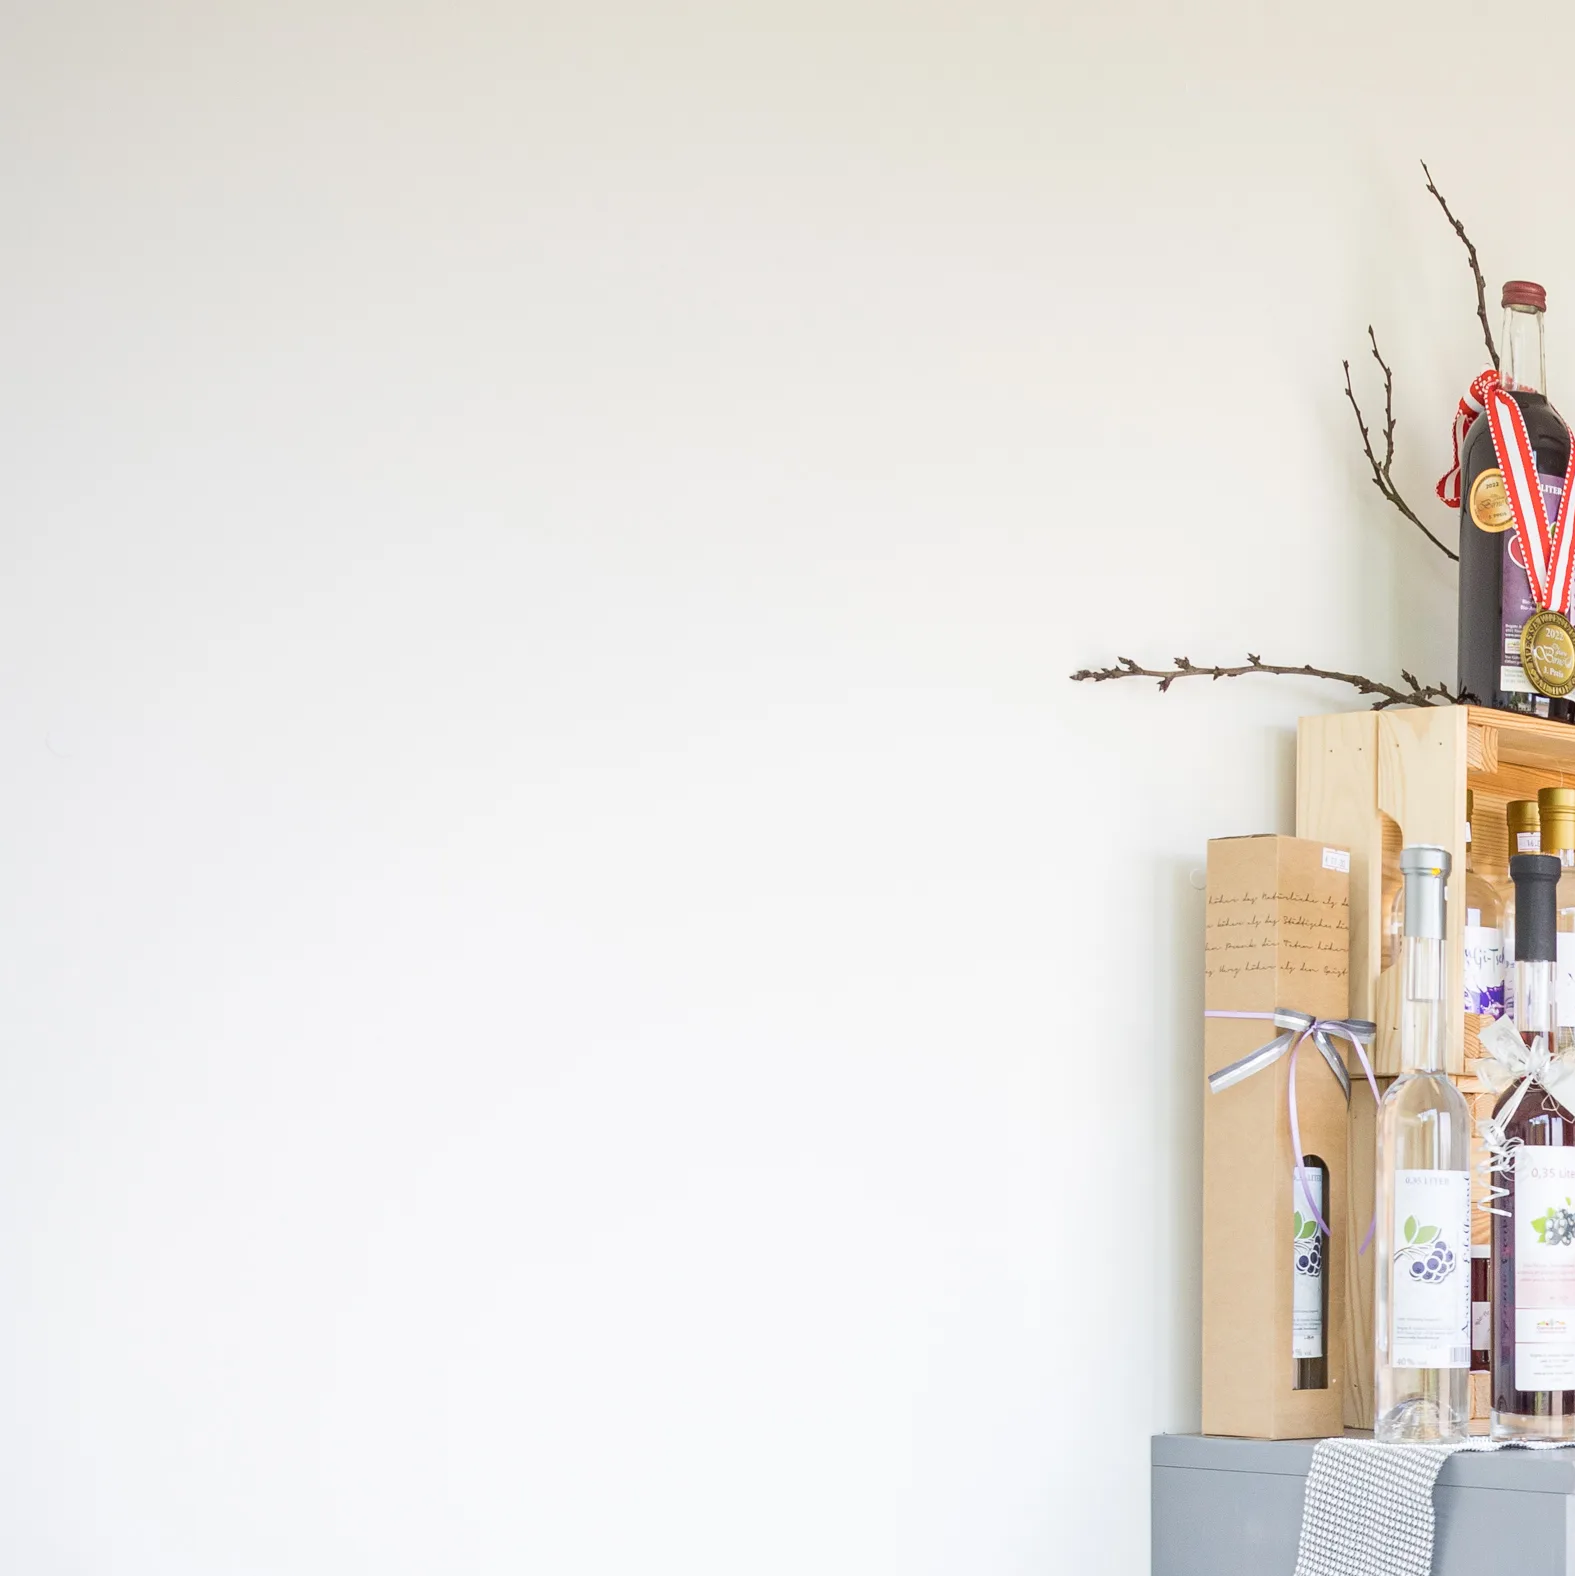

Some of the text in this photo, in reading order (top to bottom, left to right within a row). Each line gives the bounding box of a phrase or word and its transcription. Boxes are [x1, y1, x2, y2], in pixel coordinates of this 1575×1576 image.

[1541, 484, 1562, 495] LITER
[1545, 628, 1565, 640] 2022
[1531, 1168, 1555, 1179] 0,35
